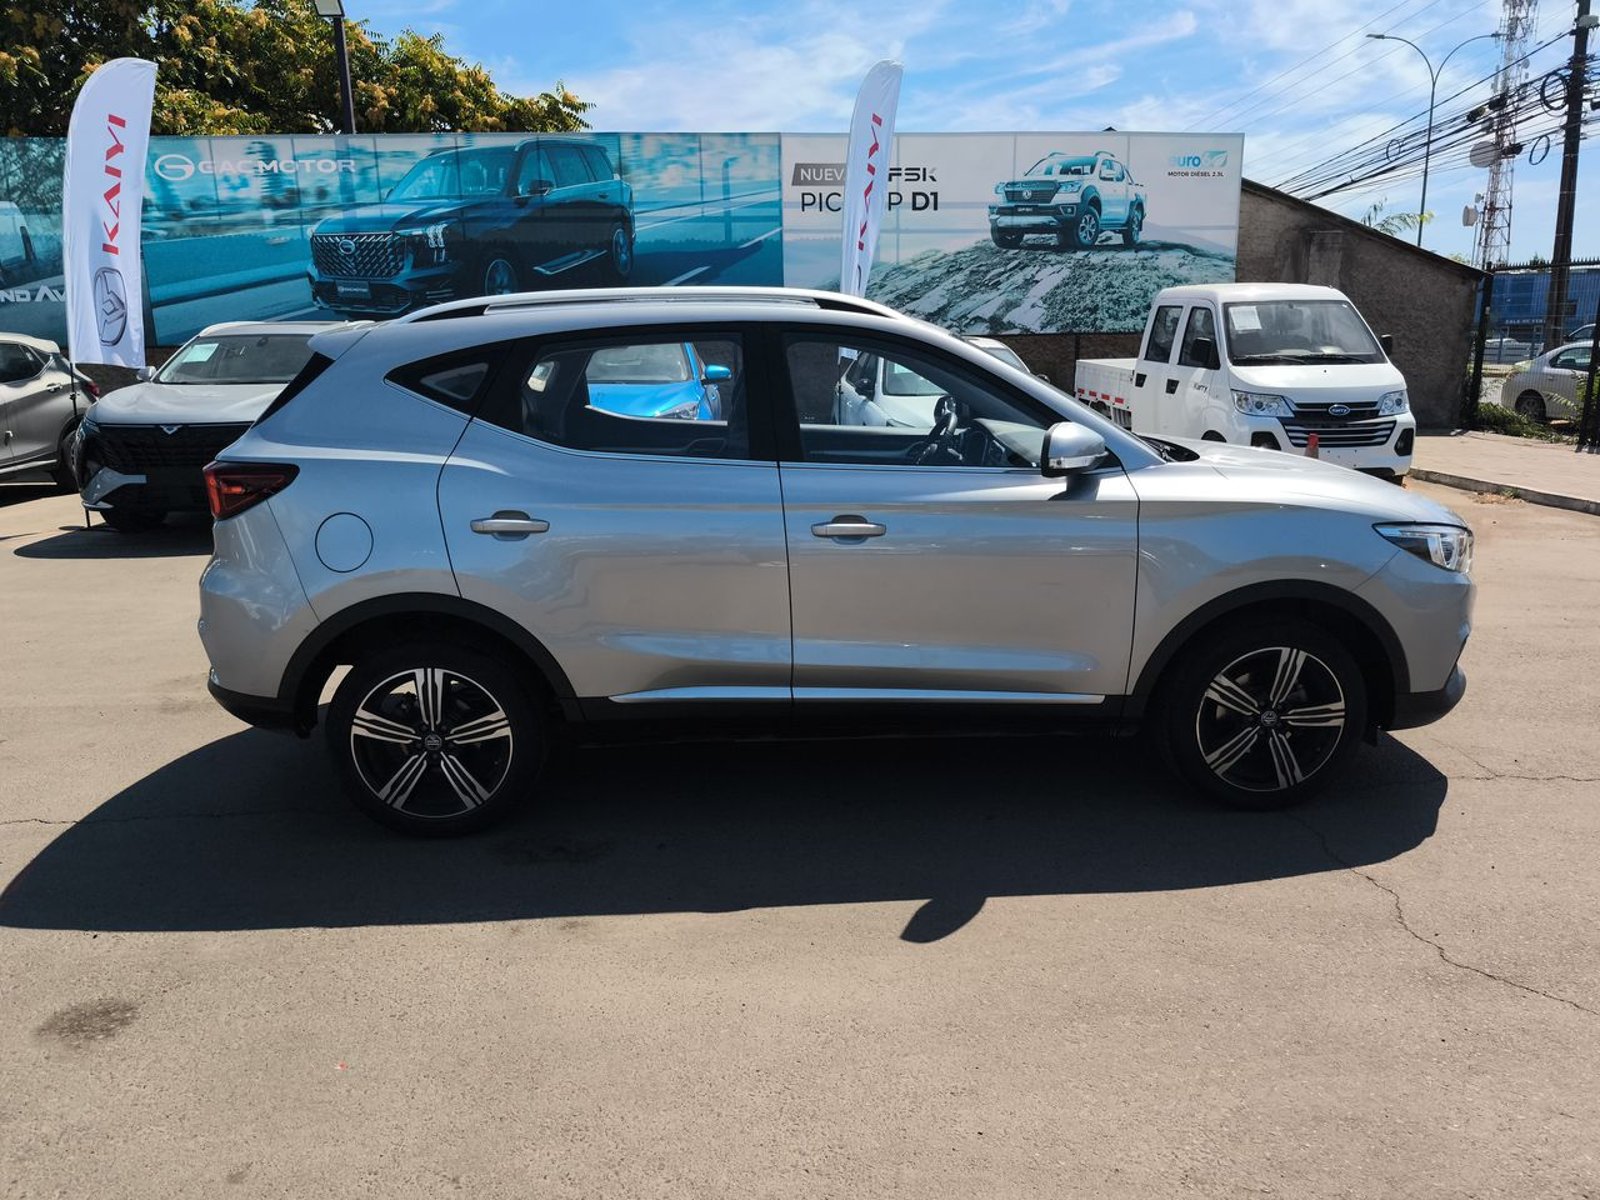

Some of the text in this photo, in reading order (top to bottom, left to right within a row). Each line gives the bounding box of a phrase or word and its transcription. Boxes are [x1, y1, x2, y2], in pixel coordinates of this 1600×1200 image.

[102, 113, 126, 255] KAIYI
[800, 167, 938, 182] NUEV FSK
[801, 191, 938, 212] PIC P D1
